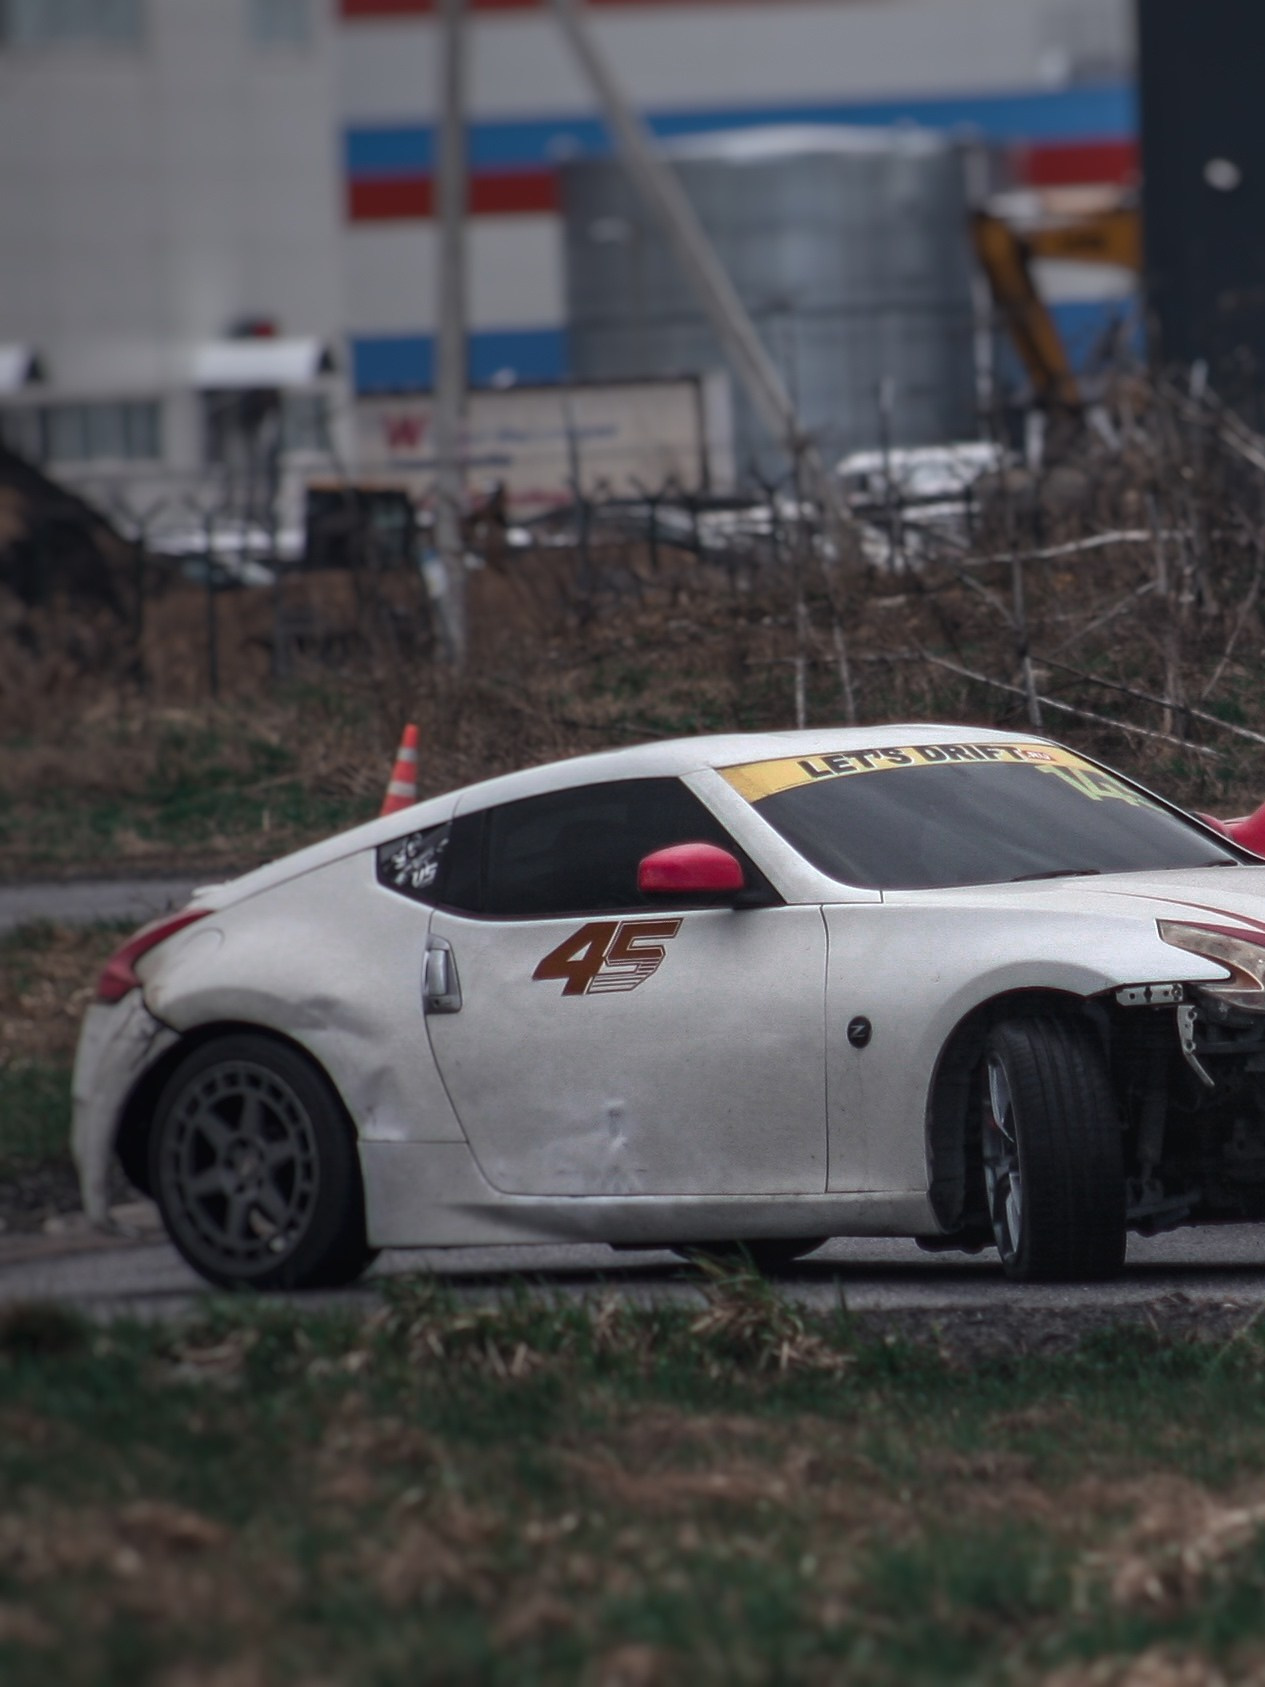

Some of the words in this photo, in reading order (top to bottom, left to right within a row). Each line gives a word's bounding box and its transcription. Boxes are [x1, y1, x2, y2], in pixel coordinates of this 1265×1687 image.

[798, 748, 914, 779] LET'S
[914, 745, 1025, 762] DRIFT
[532, 917, 684, 996] 45
